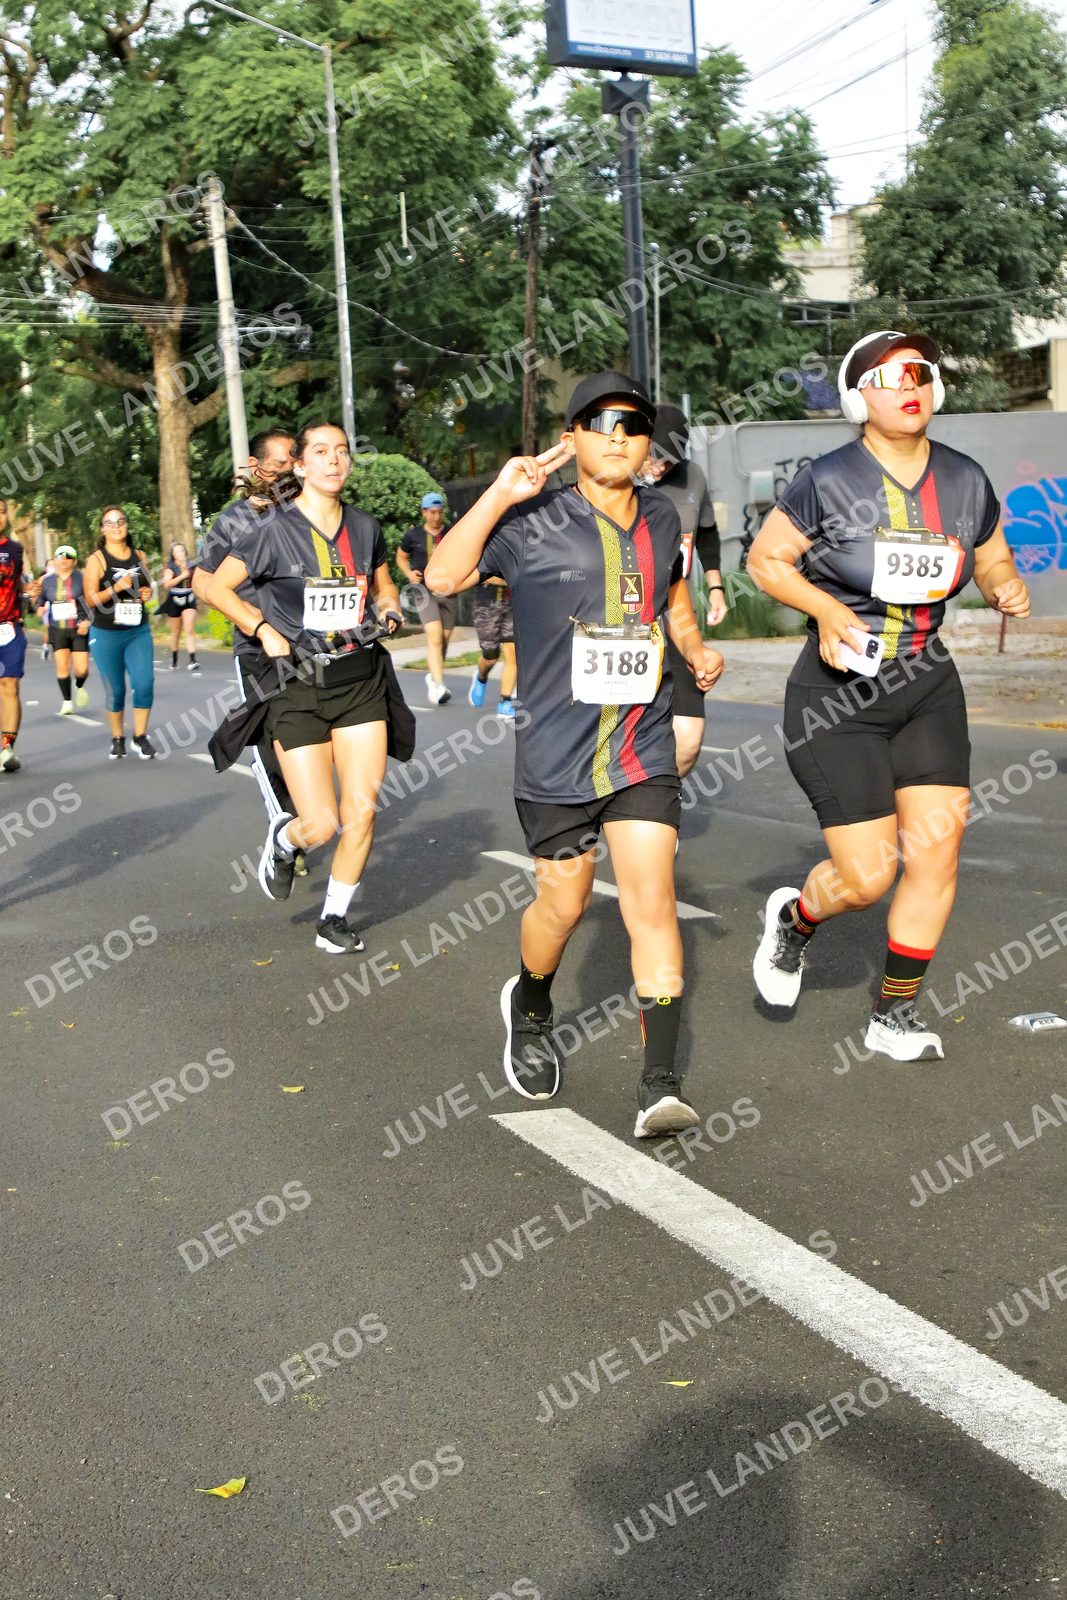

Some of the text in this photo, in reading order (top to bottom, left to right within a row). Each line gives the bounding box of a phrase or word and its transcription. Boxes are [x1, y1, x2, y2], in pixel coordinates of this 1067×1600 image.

[887, 552, 944, 578] 9385
[308, 593, 357, 612] 12115
[583, 649, 649, 676] 3188
